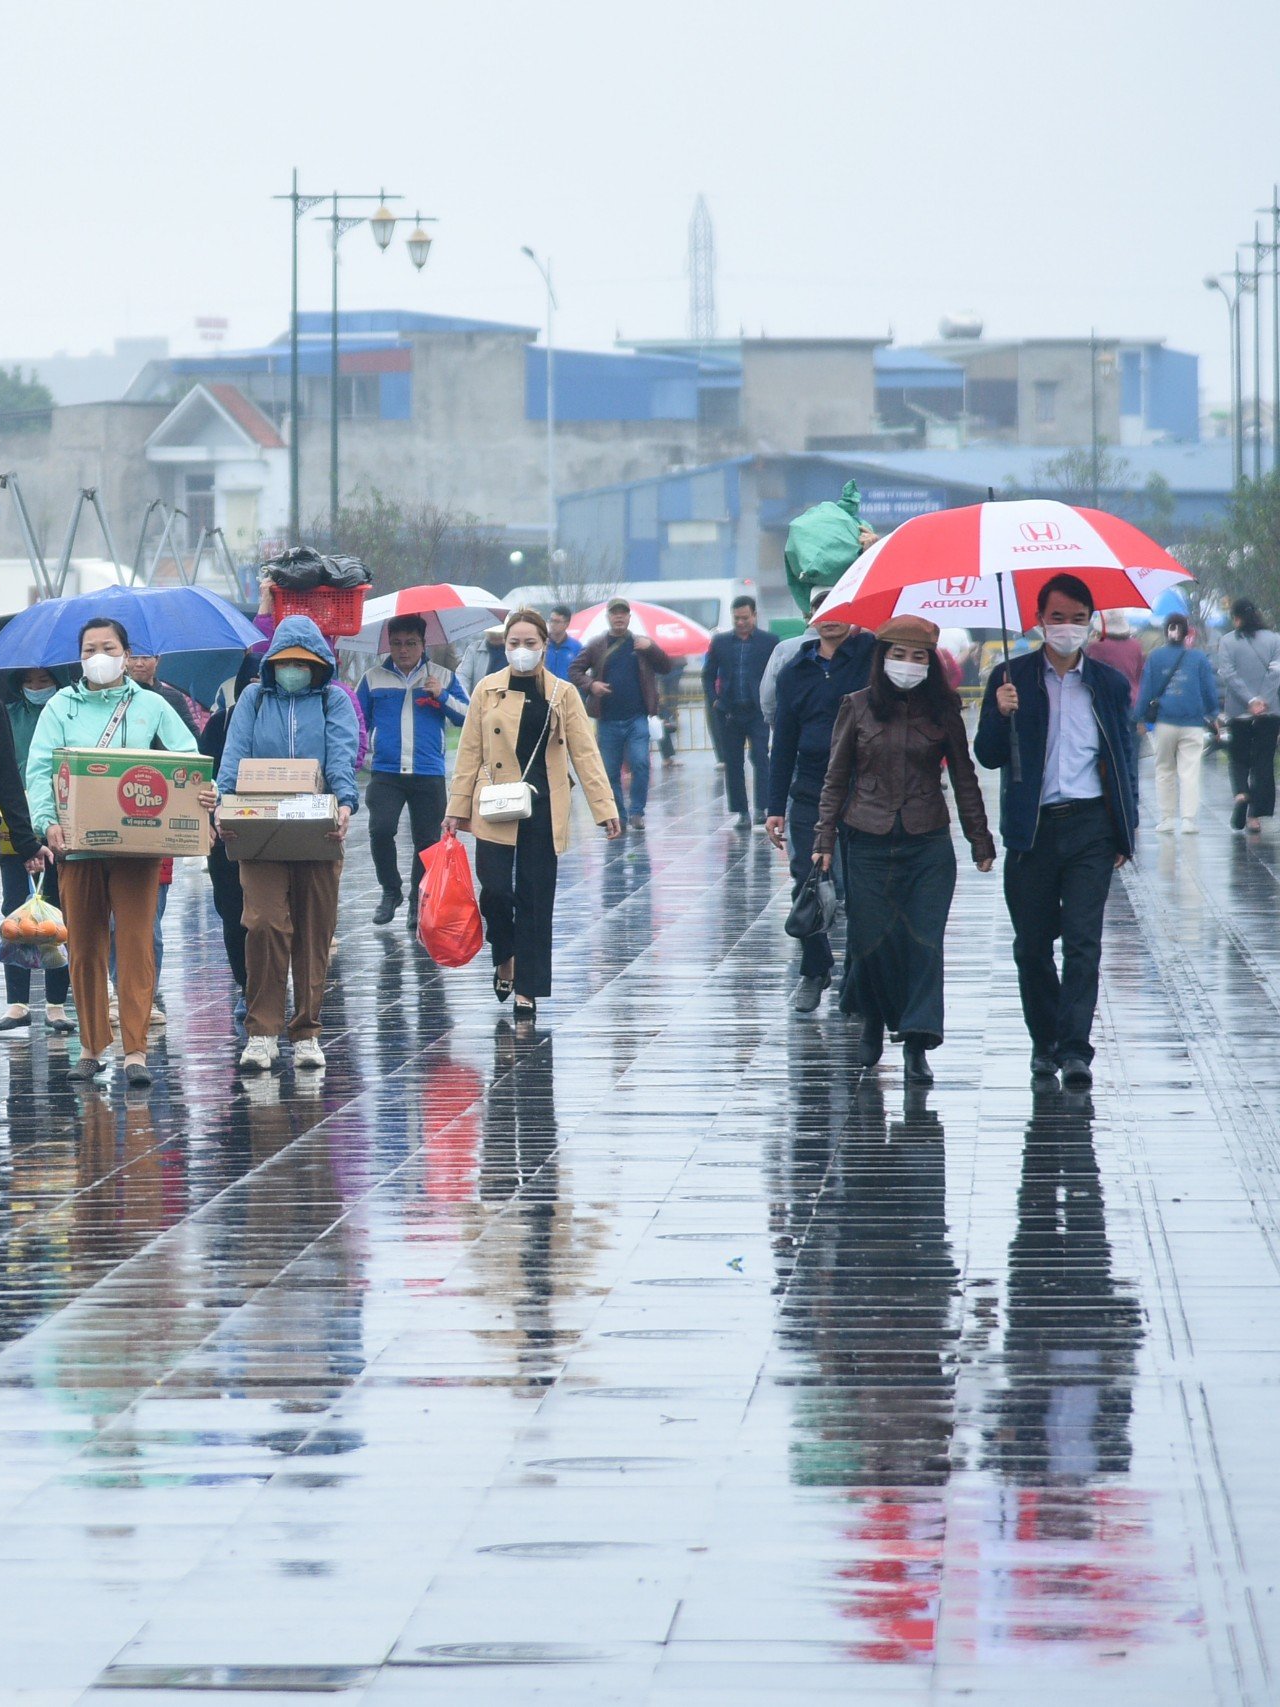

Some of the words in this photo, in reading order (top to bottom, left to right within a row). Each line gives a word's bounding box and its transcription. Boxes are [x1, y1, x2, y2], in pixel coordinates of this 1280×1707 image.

[1013, 544, 1082, 553] HONDA
[123, 782, 151, 797] One
[135, 793, 162, 806] One
